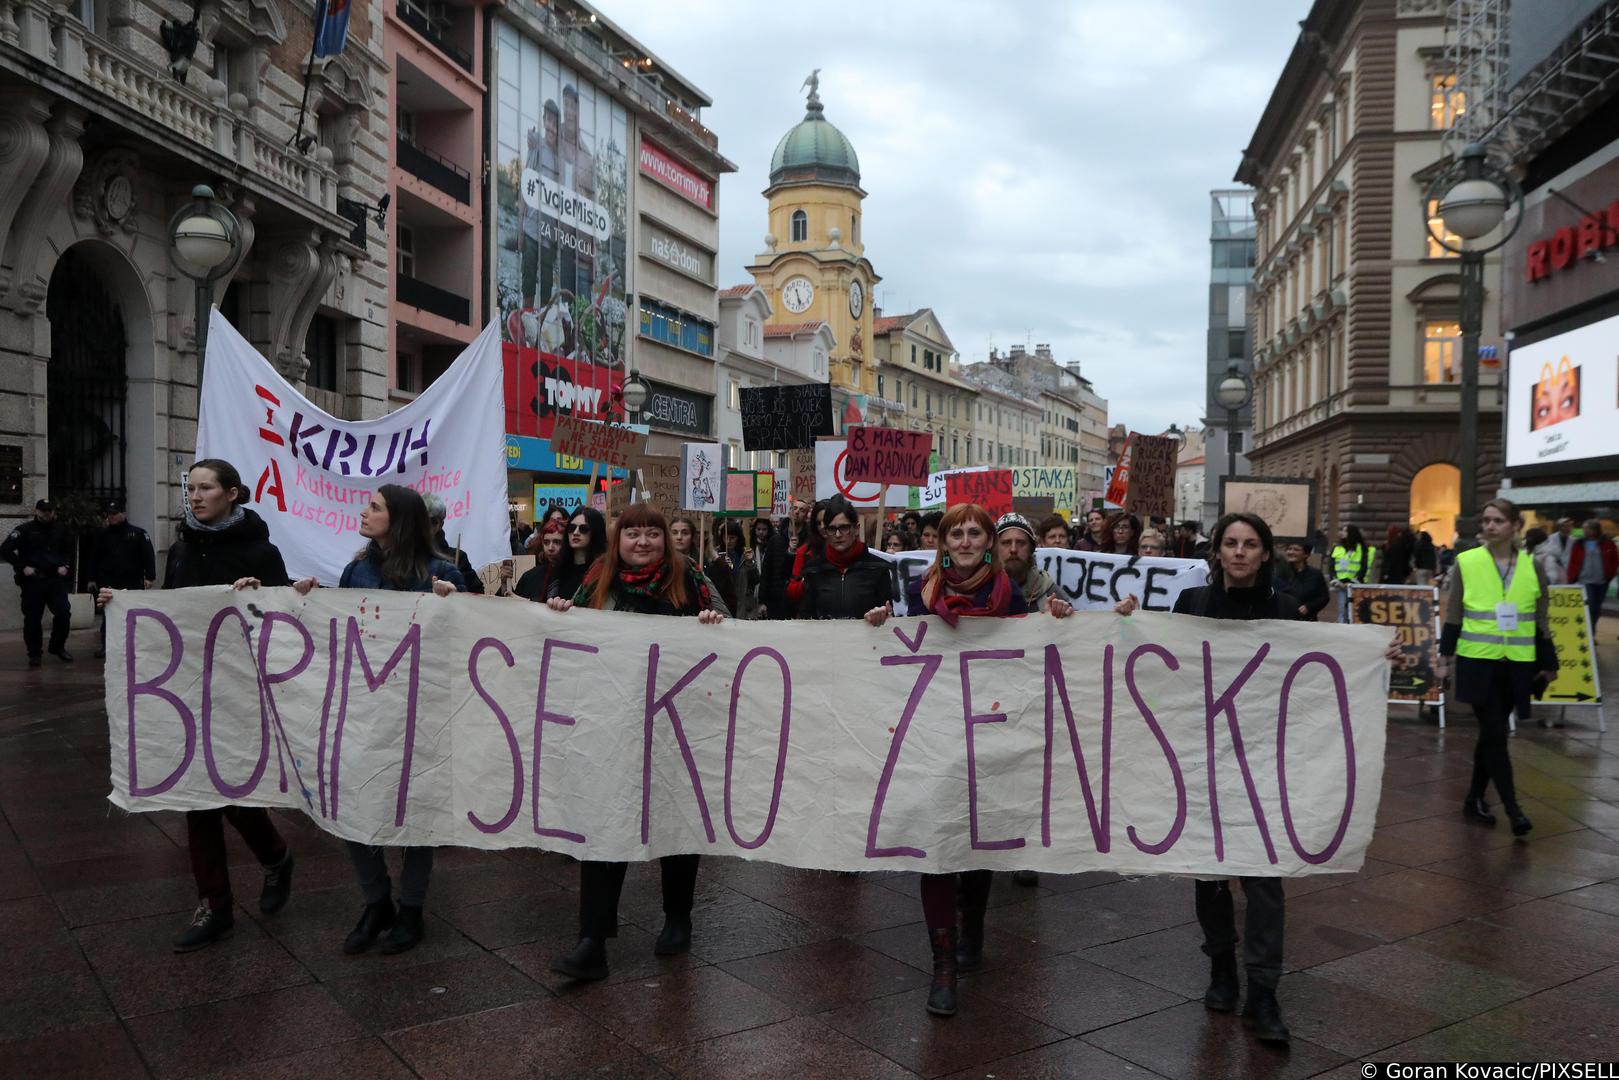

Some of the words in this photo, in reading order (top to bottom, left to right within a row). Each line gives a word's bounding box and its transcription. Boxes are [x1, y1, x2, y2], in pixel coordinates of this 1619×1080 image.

[640, 149, 709, 201] www.tommy.hr
[527, 178, 606, 232] #TvojeMisto
[651, 236, 670, 260] naš
[680, 247, 700, 275] dom
[544, 377, 602, 415] TOMMY
[651, 394, 697, 427] CENTRA
[290, 411, 431, 477] KRUH
[571, 431, 584, 443] NE
[873, 431, 921, 450] MART
[650, 463, 680, 478] TKO
[845, 454, 870, 477] DAN
[874, 450, 929, 480] RADNICA
[1012, 468, 1074, 488] OSTAVKA
[296, 464, 371, 504] Kulturn
[654, 481, 680, 491] SKUH
[795, 474, 816, 494] PAP
[944, 470, 1010, 496] TRANS
[1132, 500, 1168, 515] STVAR
[1370, 601, 1421, 624] SEX
[1396, 626, 1430, 646] OP
[126, 606, 421, 828] BORIM
[467, 637, 599, 844] SE
[641, 643, 792, 849] KO
[864, 621, 1356, 865] ŽENSKO
